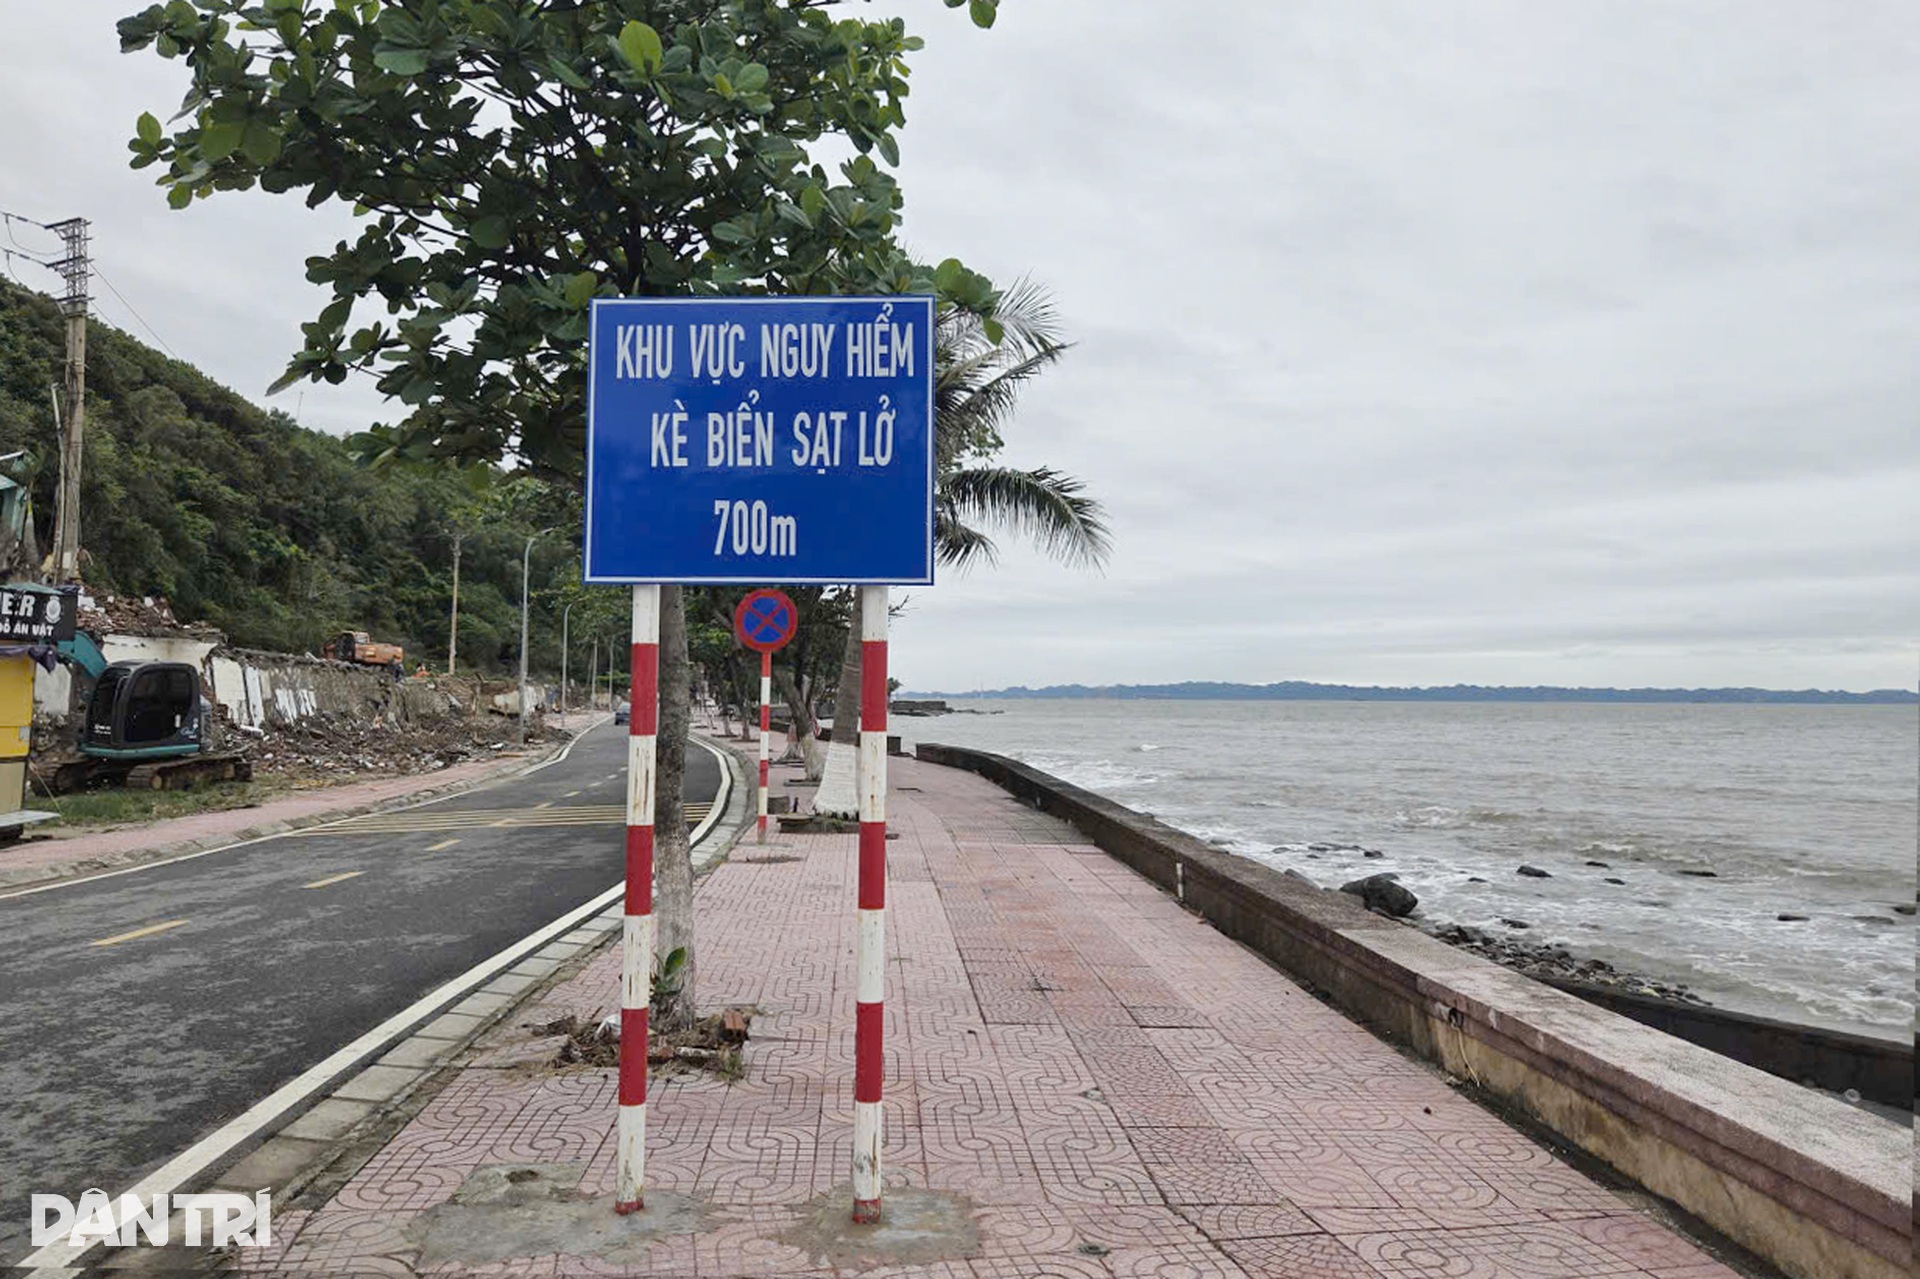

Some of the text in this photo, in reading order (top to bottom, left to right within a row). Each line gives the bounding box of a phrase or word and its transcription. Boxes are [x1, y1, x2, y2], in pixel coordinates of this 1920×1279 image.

[616, 303, 914, 385] KHU VỰC NGUY HIỂM
[651, 389, 897, 475] KÈ BIỂN SẠT LỞ
[714, 499, 797, 556] 700m
